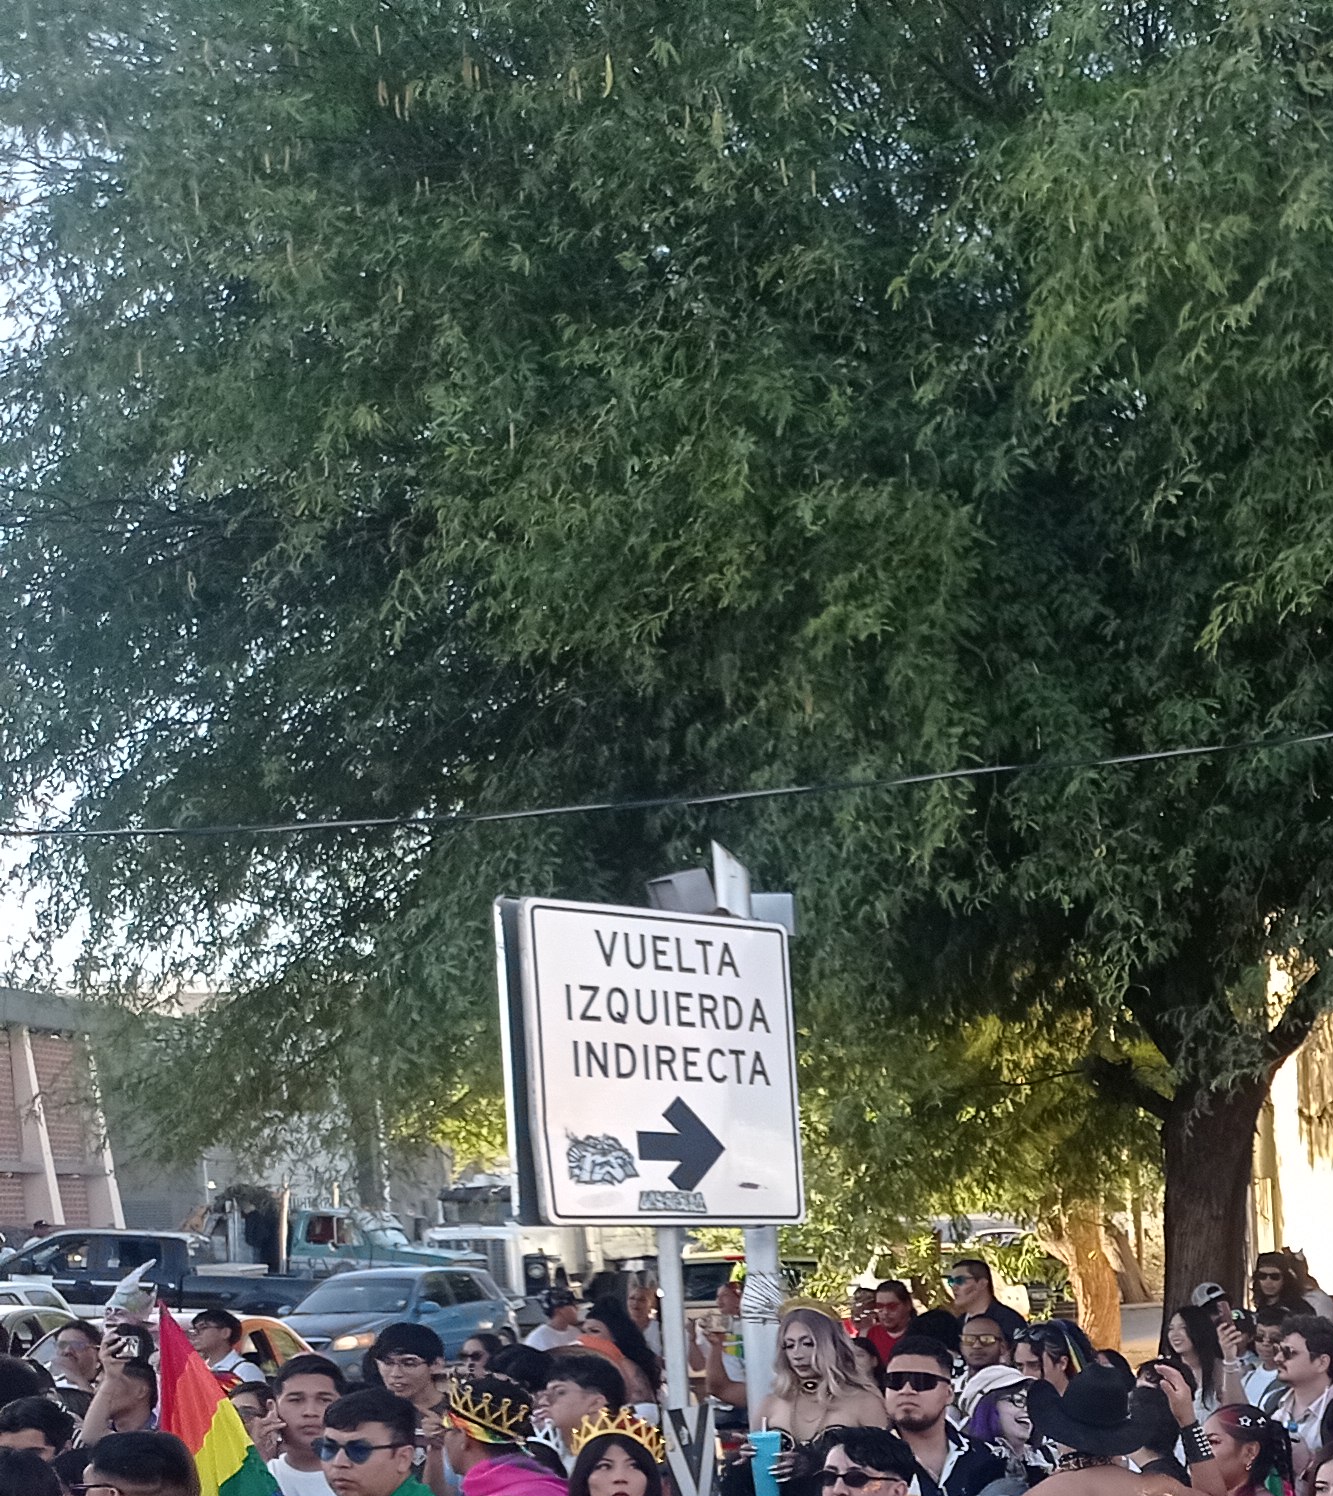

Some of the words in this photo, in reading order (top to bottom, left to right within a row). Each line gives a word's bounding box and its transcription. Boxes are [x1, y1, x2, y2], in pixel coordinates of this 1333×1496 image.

[594, 929, 741, 978] VUELTA
[565, 984, 772, 1034] IZQUIERDA
[572, 1040, 772, 1086] INDIRECTA
